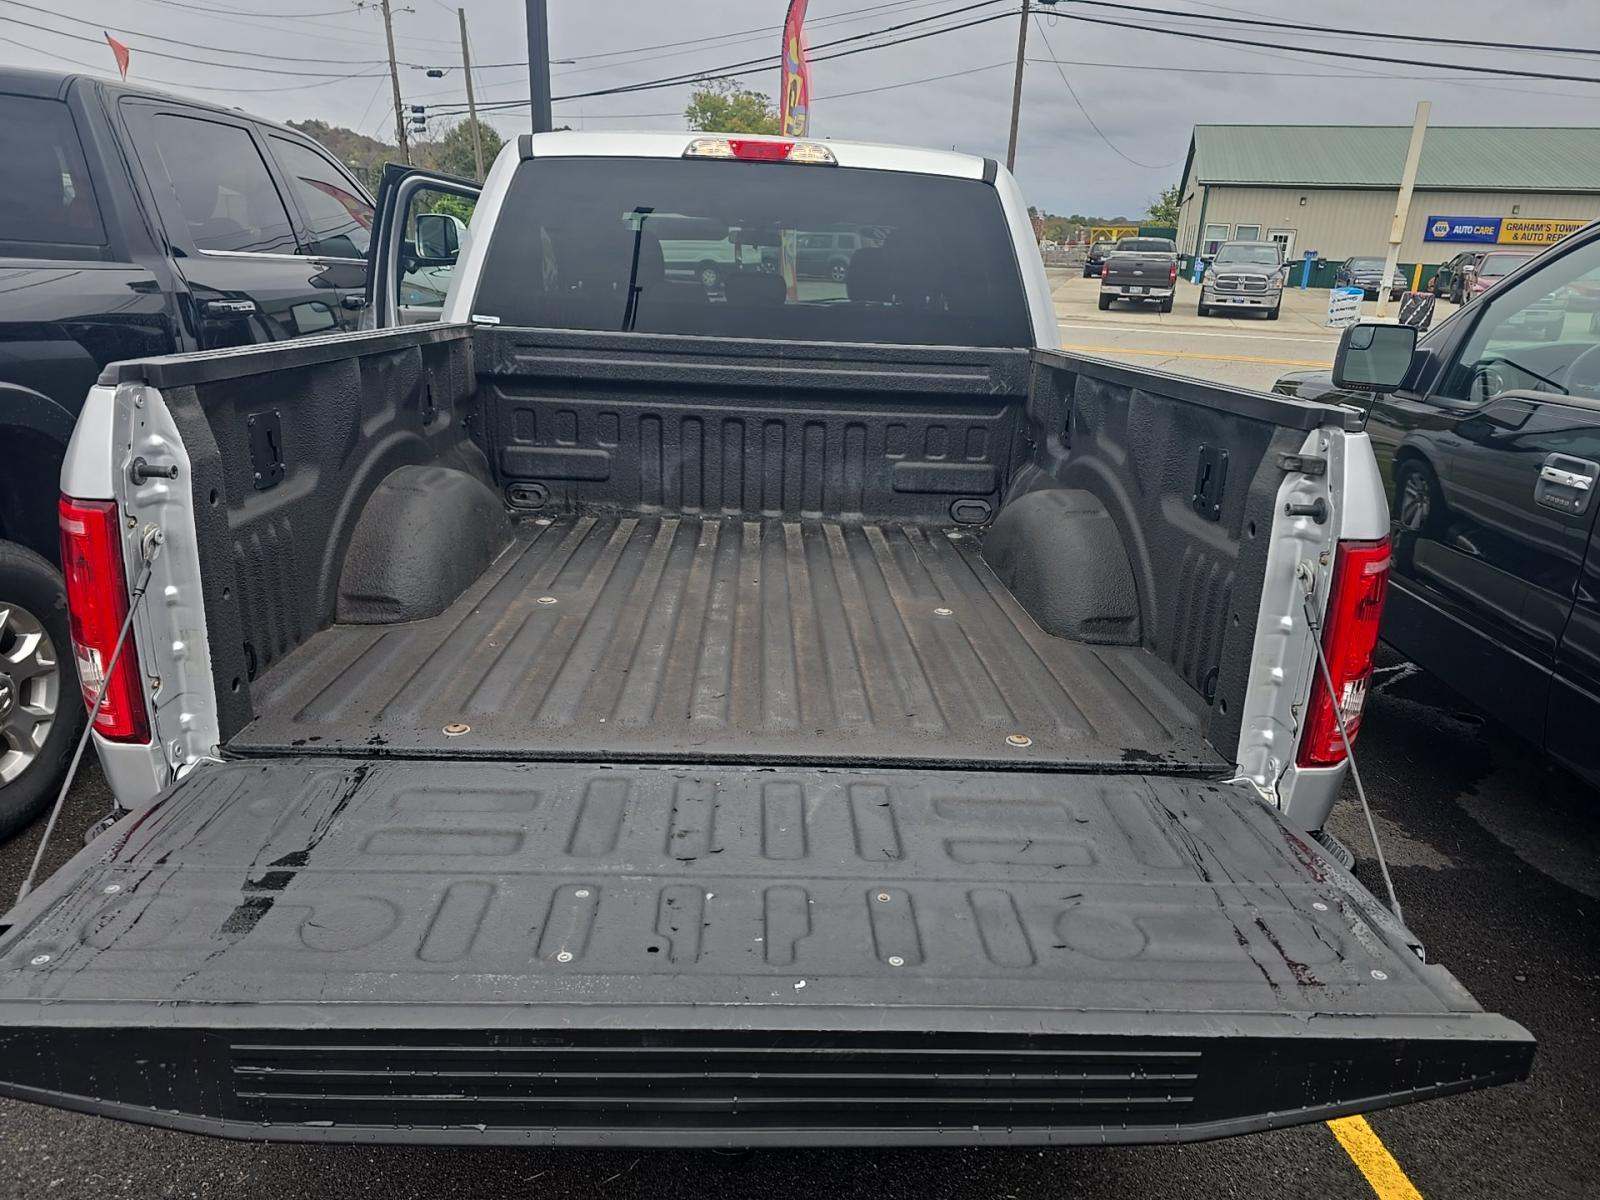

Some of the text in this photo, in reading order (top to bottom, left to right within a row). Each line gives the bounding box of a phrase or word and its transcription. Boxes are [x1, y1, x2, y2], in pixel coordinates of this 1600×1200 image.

[1453, 225, 1495, 235] AUTO CARE
[1506, 223, 1552, 232] GRAHAM'S
[1521, 233, 1543, 241] AUTO
